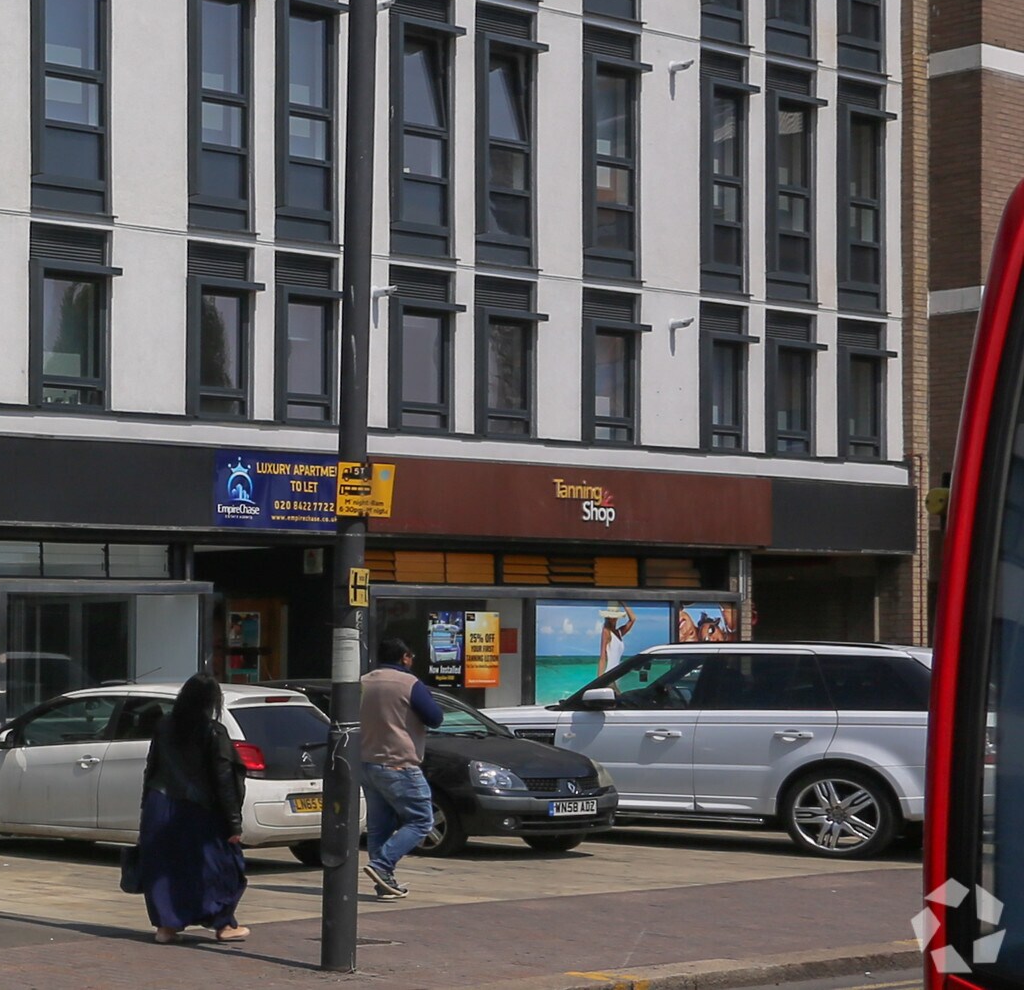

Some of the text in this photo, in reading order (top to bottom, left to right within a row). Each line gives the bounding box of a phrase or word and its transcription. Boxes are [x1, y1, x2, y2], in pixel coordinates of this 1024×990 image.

[256, 462, 338, 477] LUXURY APARTME
[290, 480, 319, 493] TO LET
[553, 479, 603, 505] Tanning
[217, 503, 260, 515] EmpireChase
[274, 500, 335, 512] 020 8422 7722
[582, 500, 615, 527] Shop
[484, 633, 495, 643] OFF
